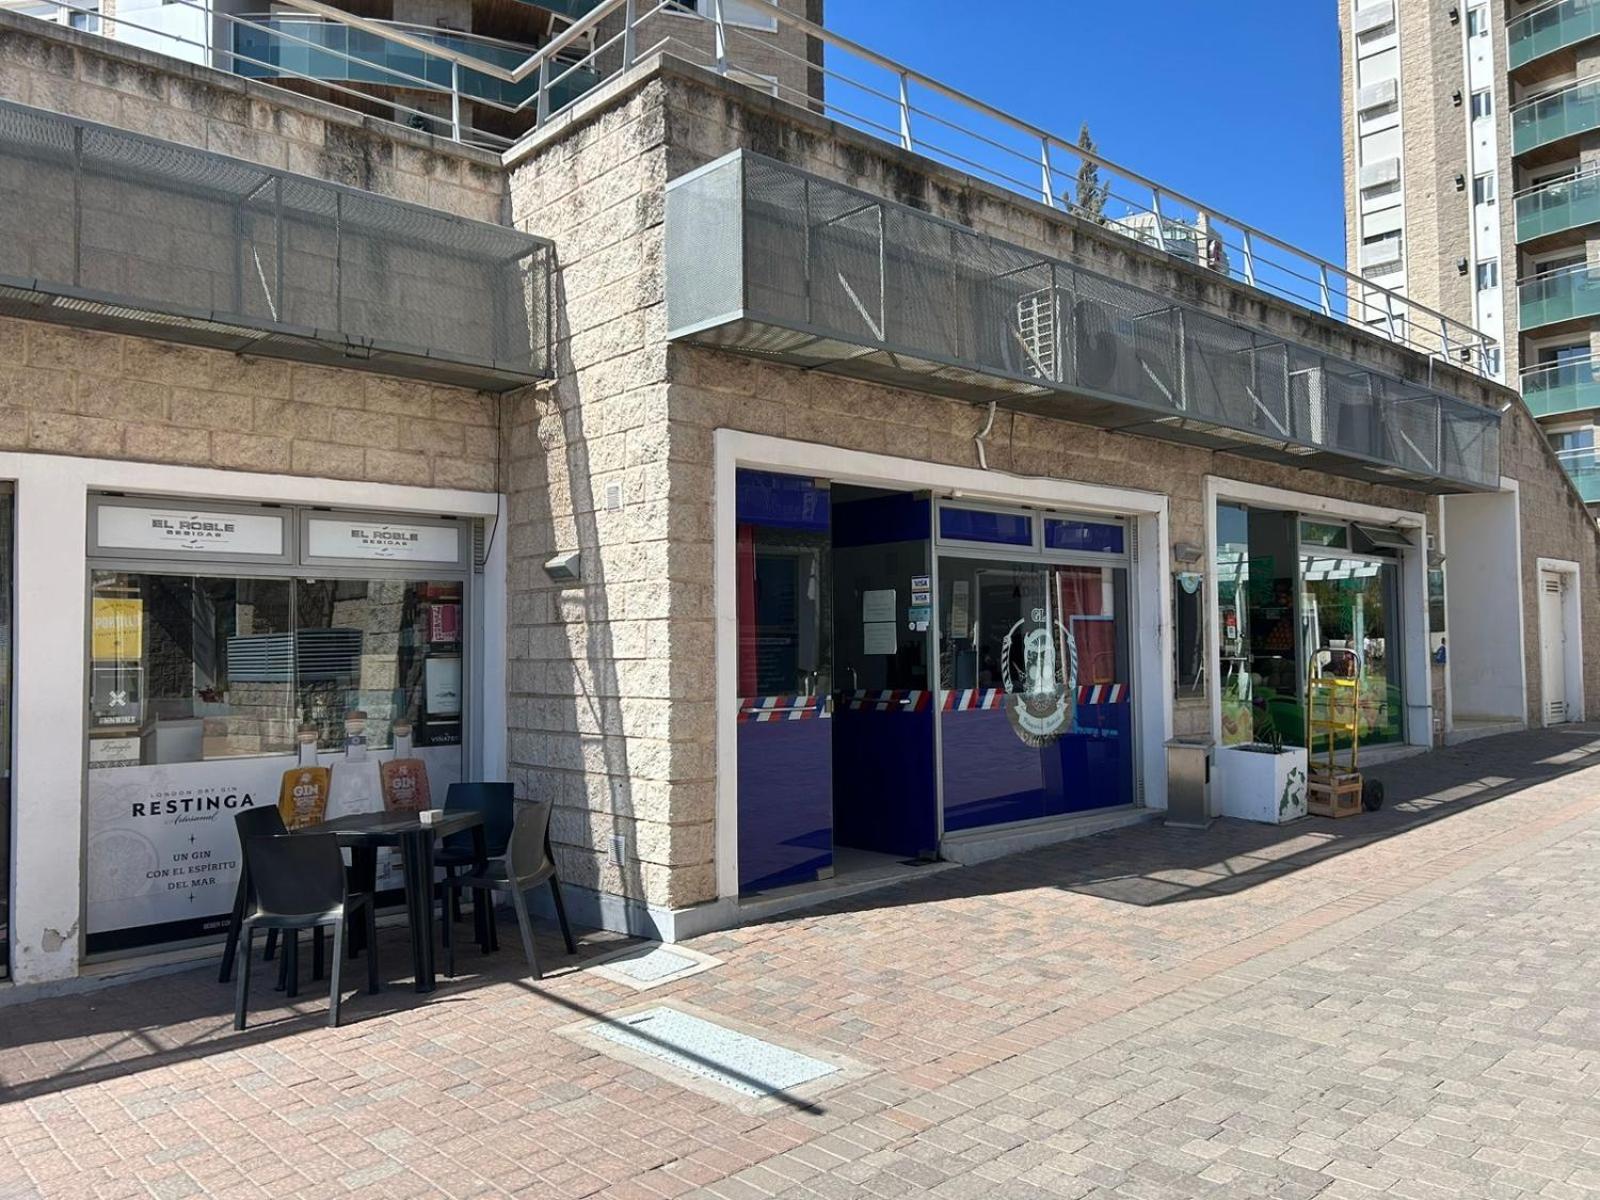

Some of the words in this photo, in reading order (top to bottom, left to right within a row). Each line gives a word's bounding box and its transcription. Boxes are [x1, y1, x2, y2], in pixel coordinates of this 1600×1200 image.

[152, 519, 174, 529] EL
[179, 521, 235, 532] ROBLE
[351, 530, 369, 538] EL
[373, 531, 418, 541] ROBLE
[392, 777, 415, 789] GIN
[150, 791, 192, 799] LONDON
[293, 784, 318, 797] GIN
[132, 794, 254, 817] RESTINGA
[173, 853, 188, 861] UN
[191, 850, 211, 860] GIN
[146, 869, 170, 879] CON
[172, 868, 185, 876] EL
[167, 881, 188, 891] DEL
[191, 877, 216, 888] MAR
